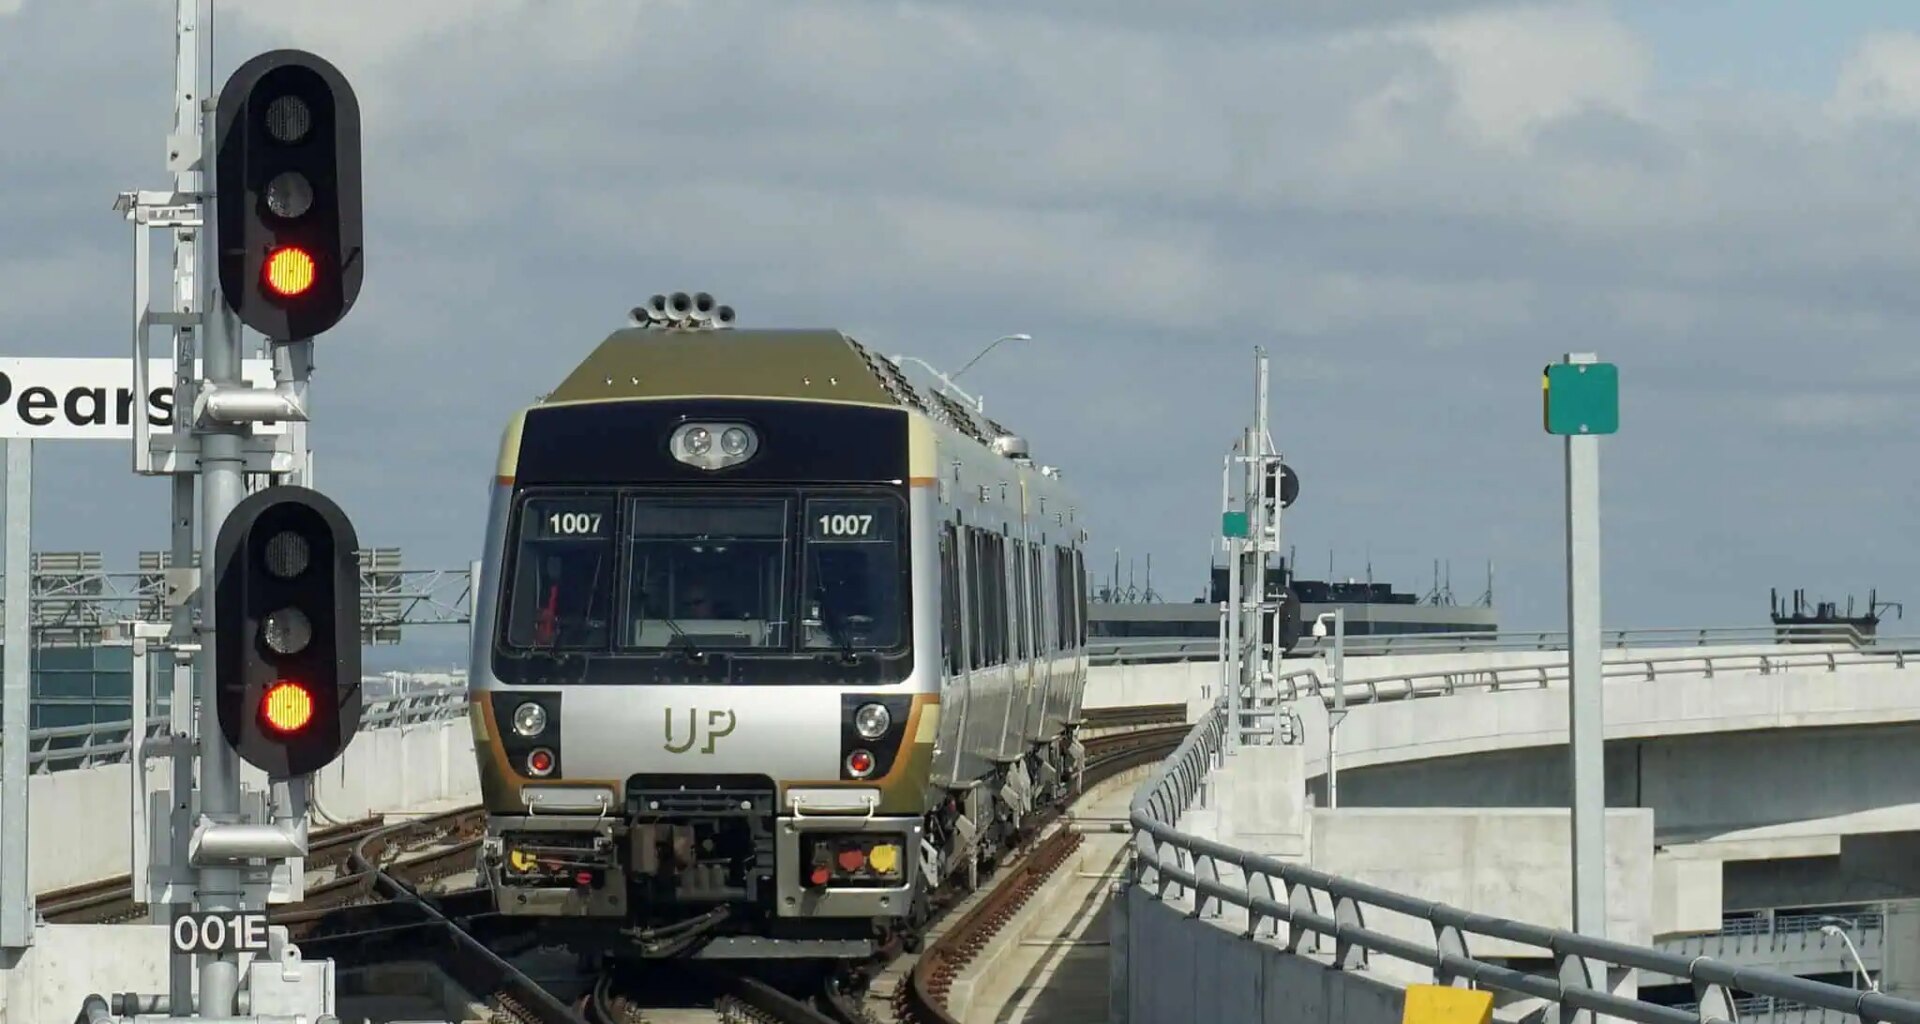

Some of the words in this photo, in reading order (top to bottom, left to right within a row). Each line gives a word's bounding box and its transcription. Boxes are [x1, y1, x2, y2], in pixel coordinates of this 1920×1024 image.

[0, 370, 276, 427] ears
[550, 513, 601, 535] 1007
[819, 514, 873, 536] 1007
[663, 707, 737, 754] UP
[174, 914, 268, 951] 001E
